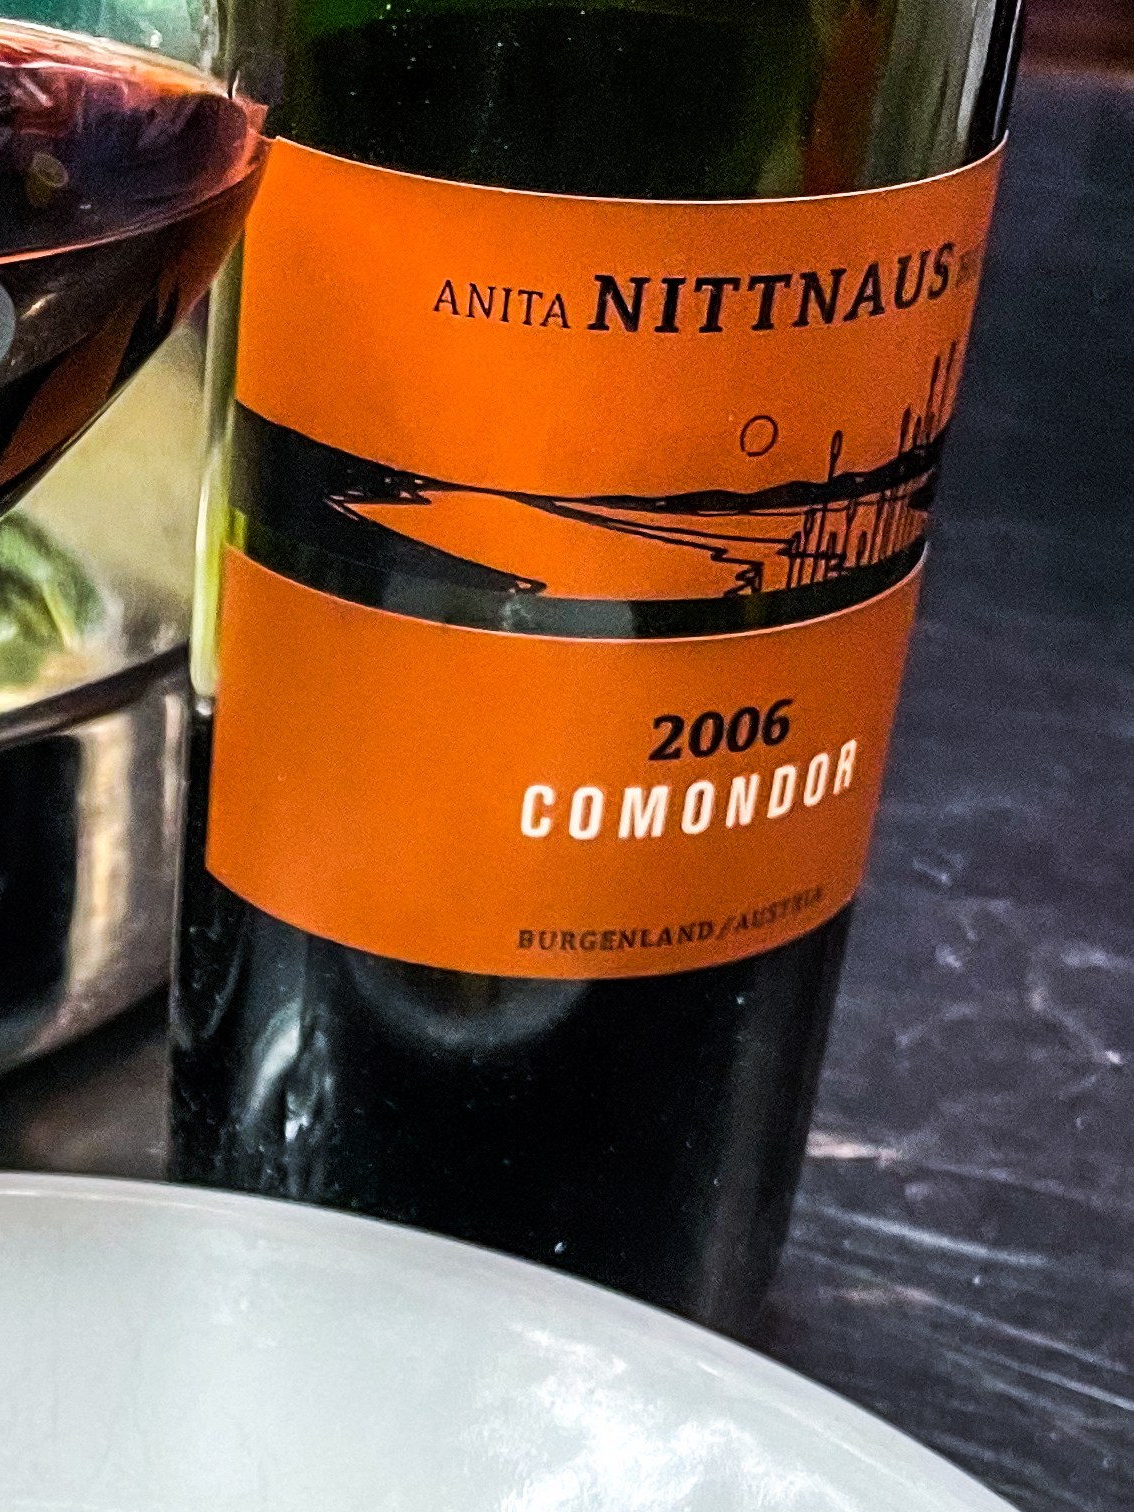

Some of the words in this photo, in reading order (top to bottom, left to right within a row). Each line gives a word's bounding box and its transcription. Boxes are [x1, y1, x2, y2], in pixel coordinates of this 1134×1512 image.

[432, 278, 572, 329] ANITA
[586, 242, 955, 334] NITTNAUS
[648, 698, 794, 762] 2006
[520, 738, 858, 840] COMONDOR
